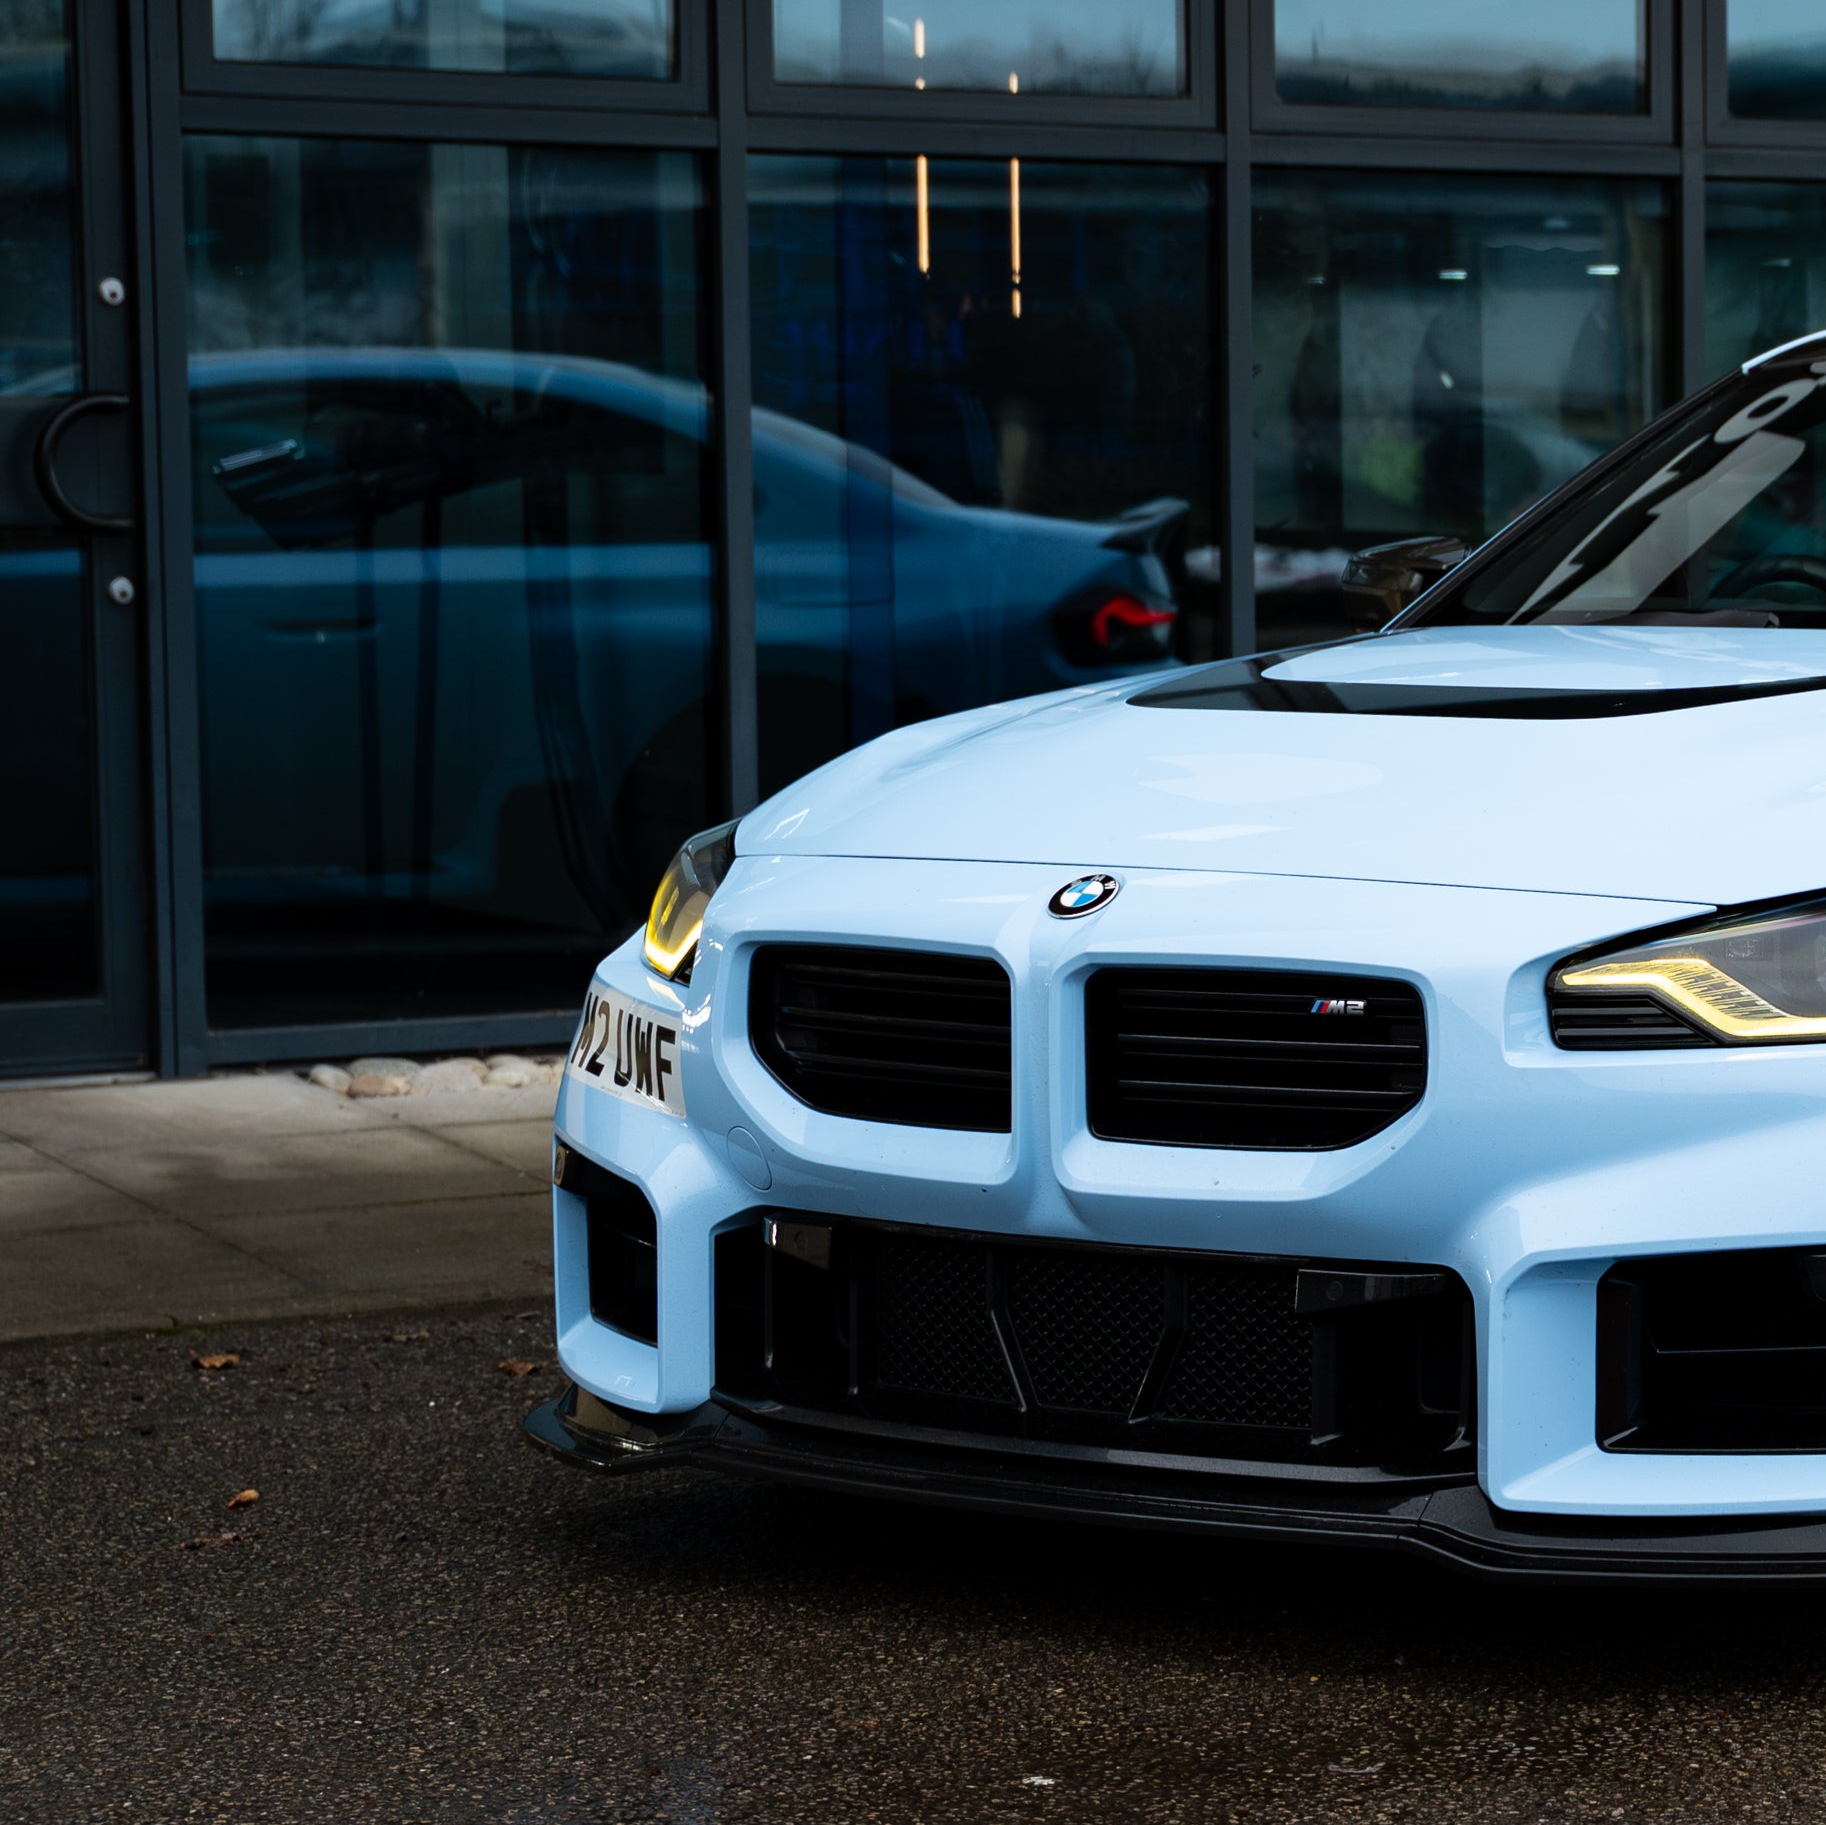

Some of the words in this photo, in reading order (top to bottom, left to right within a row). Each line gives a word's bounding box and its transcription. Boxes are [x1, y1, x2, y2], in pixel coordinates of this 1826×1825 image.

[1326, 999, 1365, 1014] M2
[571, 992, 610, 1077] M2
[614, 1009, 676, 1102] UWF
